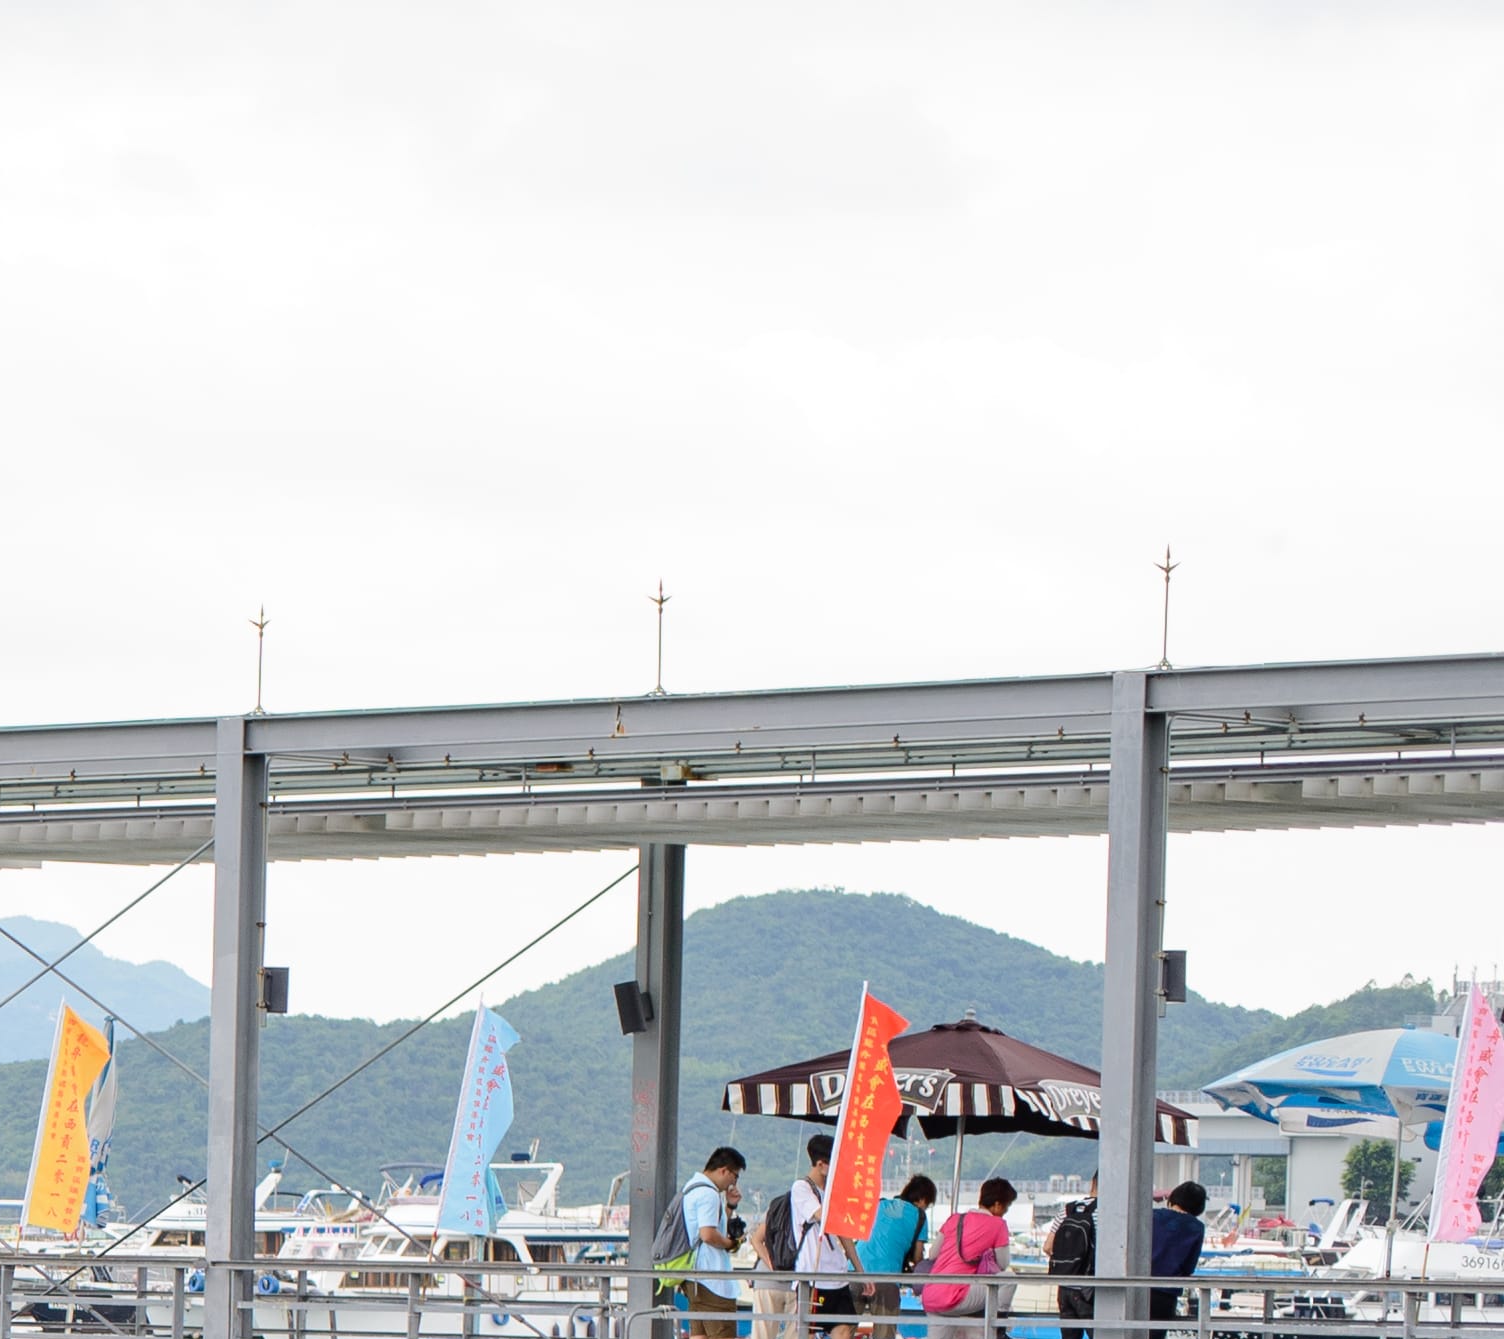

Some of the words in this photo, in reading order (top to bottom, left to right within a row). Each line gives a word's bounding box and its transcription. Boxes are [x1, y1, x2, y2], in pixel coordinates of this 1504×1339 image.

[1298, 1055, 1374, 1064] POCARI
[820, 1071, 939, 1104] Der's
[1055, 1083, 1101, 1112] Dreye
[843, 1058, 889, 1226] 盛會在西貢二零一八
